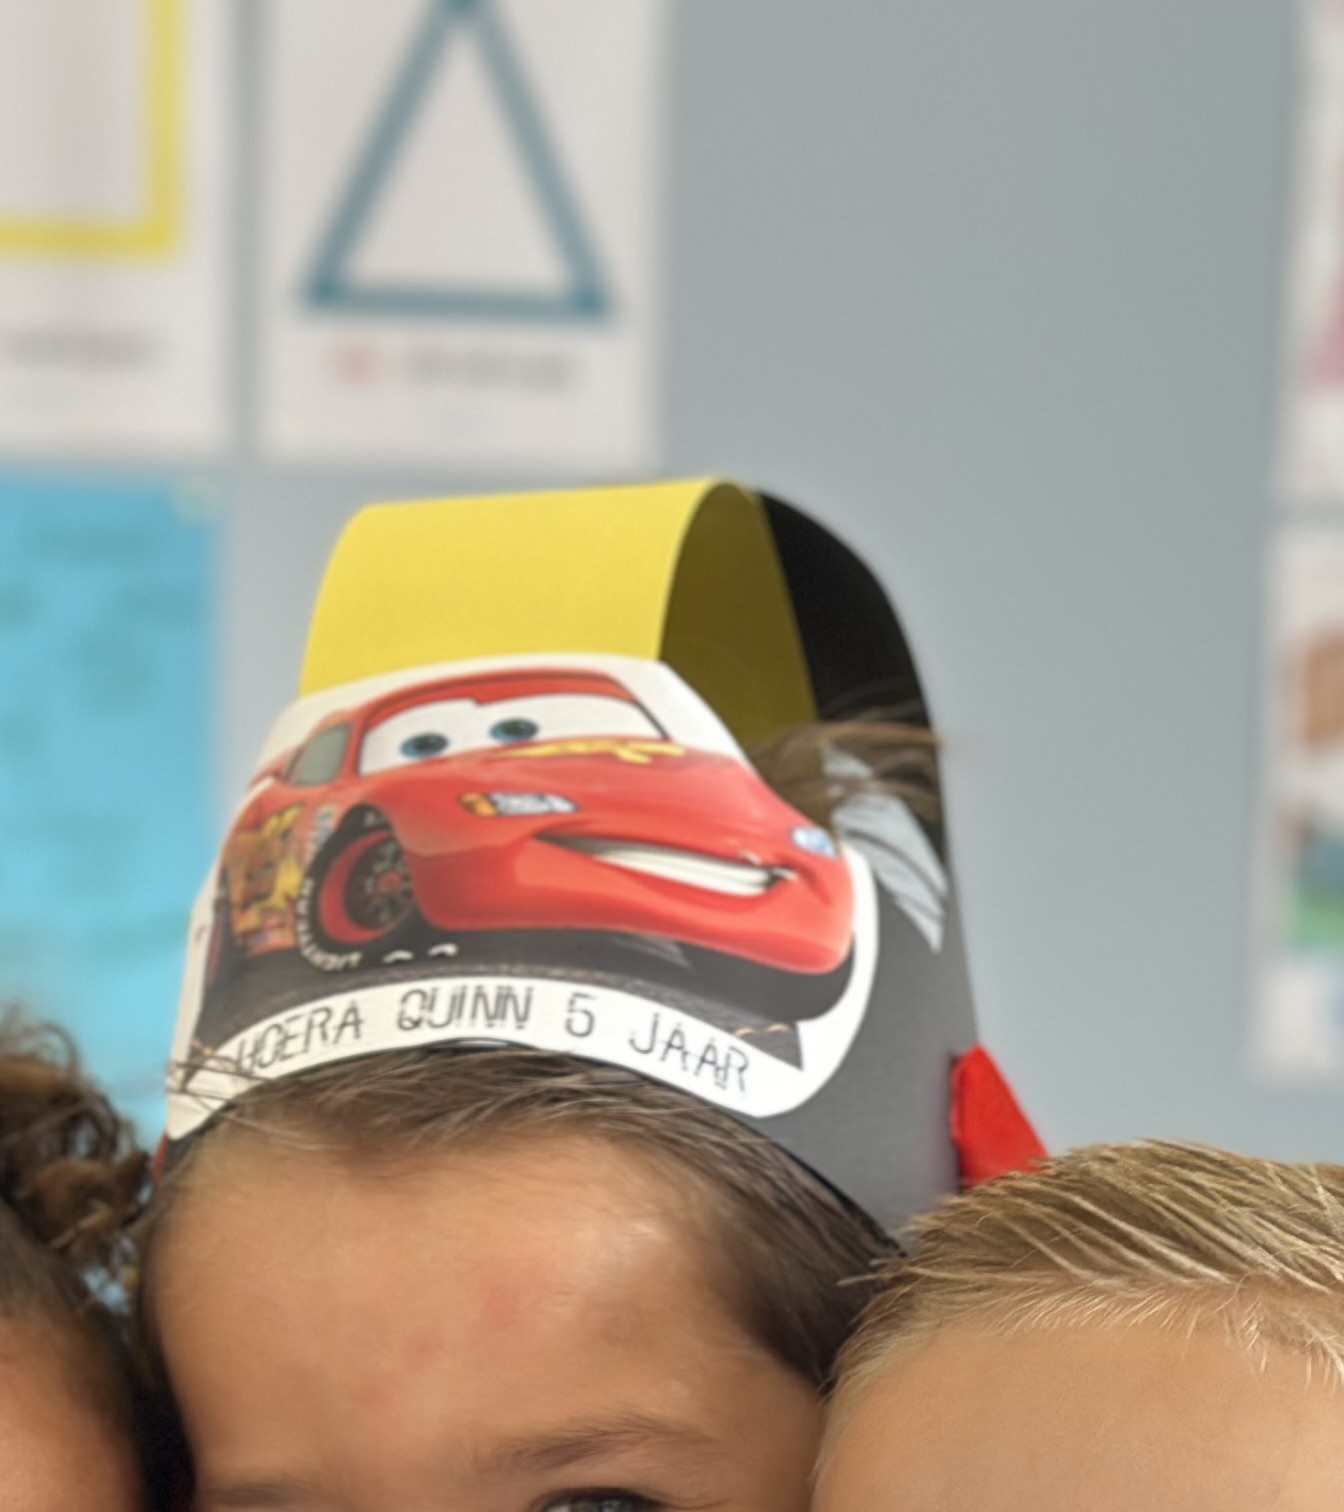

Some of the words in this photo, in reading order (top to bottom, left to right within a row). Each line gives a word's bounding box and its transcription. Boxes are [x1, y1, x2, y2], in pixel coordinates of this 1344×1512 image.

[235, 1000, 365, 1076] HOERA
[397, 984, 534, 1032] QUINN
[565, 992, 596, 1038] 5
[628, 1012, 750, 1096] JAAR
